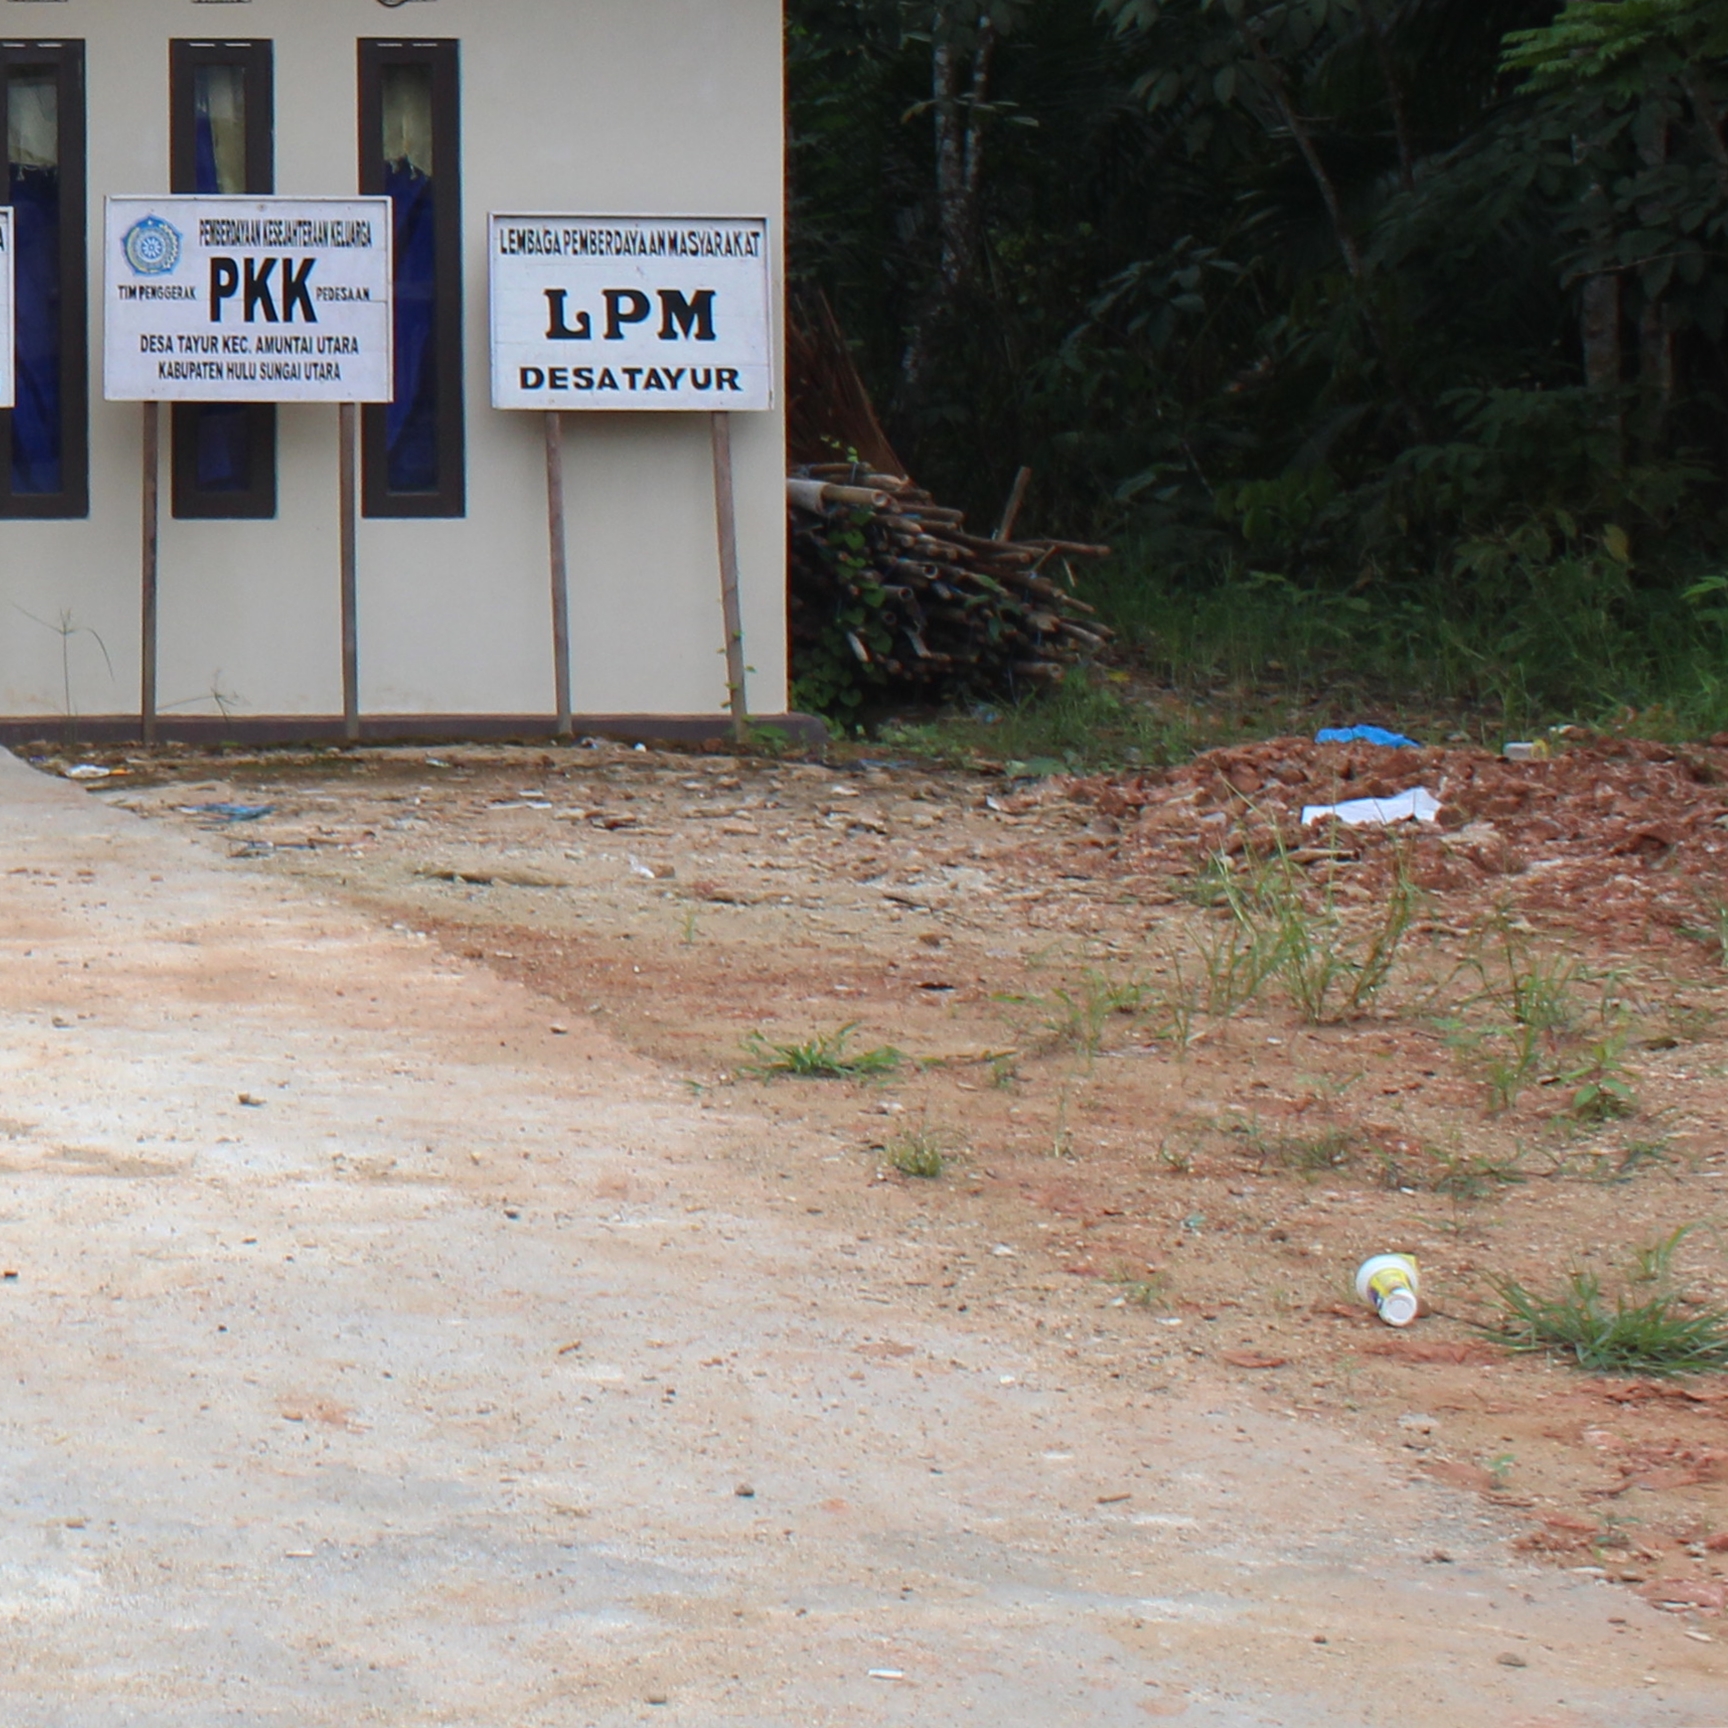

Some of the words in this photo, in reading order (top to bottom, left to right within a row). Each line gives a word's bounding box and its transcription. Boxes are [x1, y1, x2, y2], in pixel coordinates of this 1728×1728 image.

[200, 219, 261, 247] PEMBERDAYAAN
[331, 220, 372, 247] KELUARGA
[500, 228, 562, 256] LEMBAGA
[667, 231, 761, 258] MASYARAKAT
[118, 285, 137, 300] TIM
[139, 285, 197, 301] PENGGERAK
[209, 257, 318, 323] PKK
[317, 287, 370, 301] PEDESAAN
[544, 288, 717, 341] LPM
[140, 334, 173, 354] DESA
[177, 335, 218, 354] TAYUR
[222, 336, 252, 354] KEC.
[255, 336, 313, 355] AMUNTAI
[317, 336, 359, 355] UTARA
[158, 361, 223, 380] KABUPATEN
[226, 362, 256, 380] HULU
[259, 363, 301, 381] SUNGAI
[304, 363, 341, 381] UTARA
